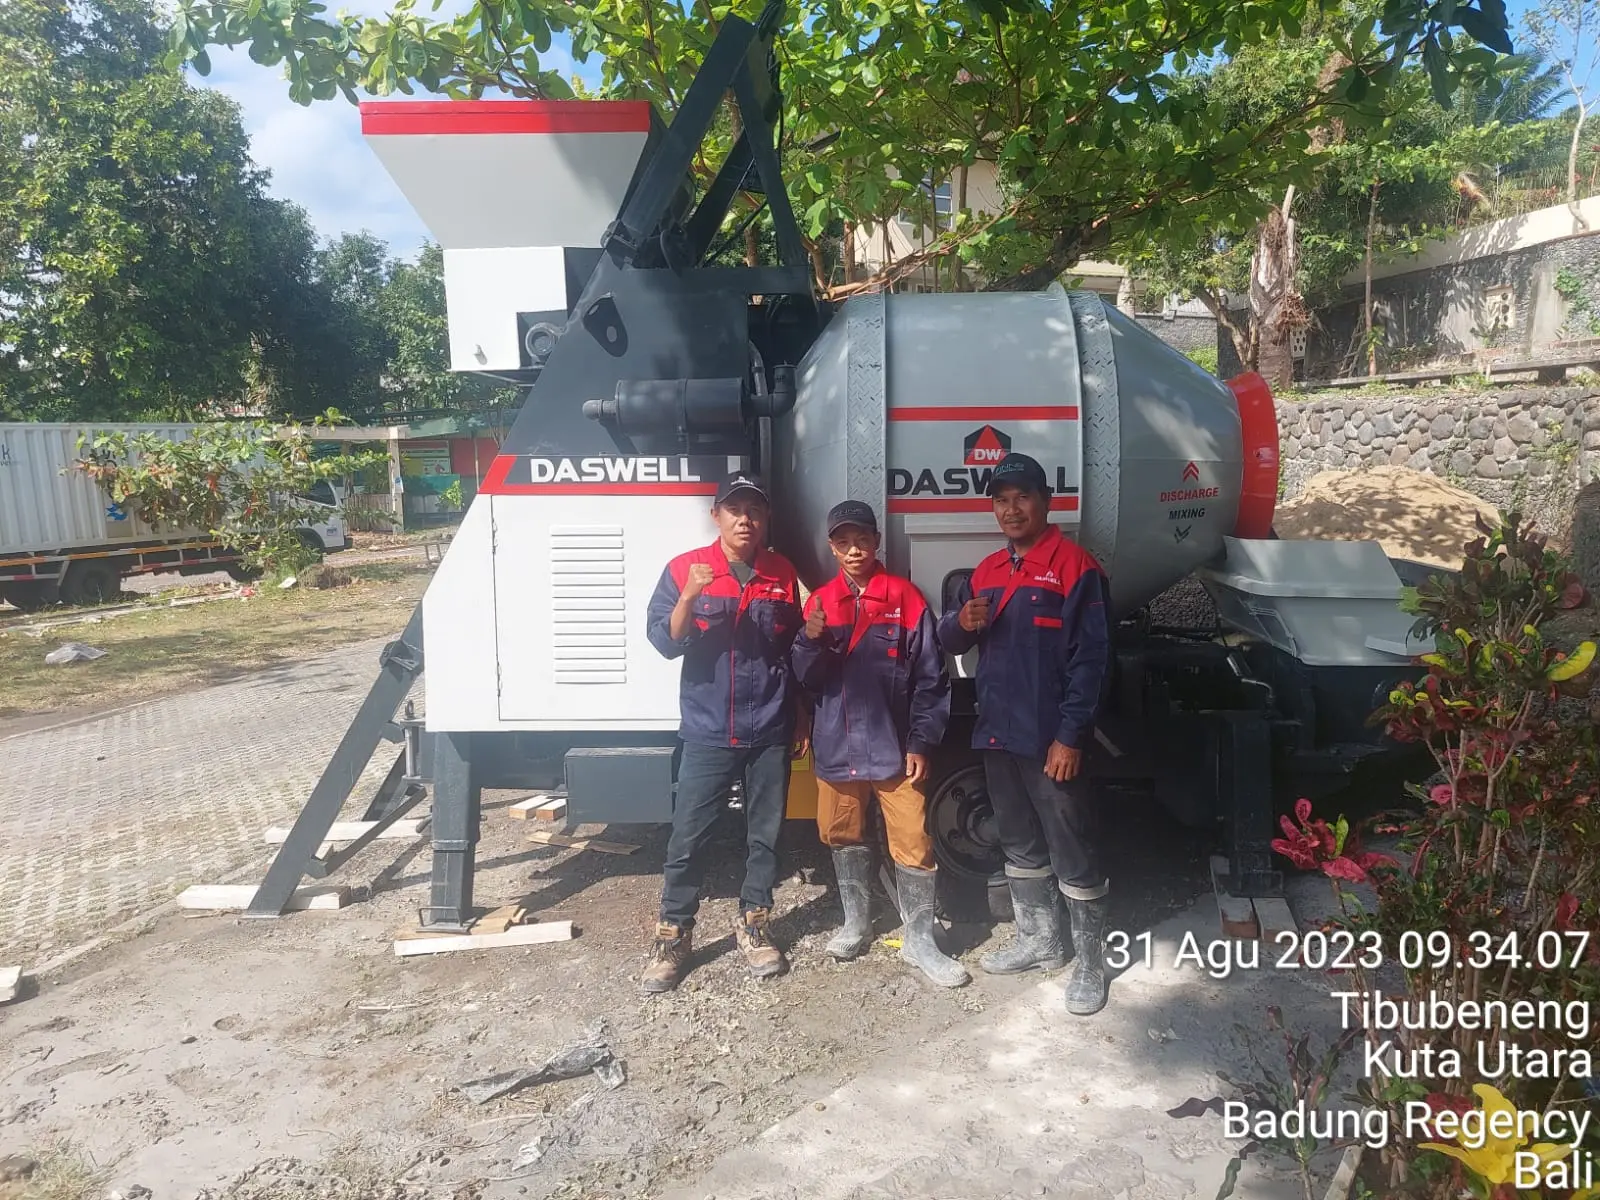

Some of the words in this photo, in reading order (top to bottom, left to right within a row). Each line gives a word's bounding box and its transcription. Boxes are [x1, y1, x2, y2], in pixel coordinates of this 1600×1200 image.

[974, 449, 1002, 461] DW
[530, 457, 701, 483] DASWELL
[887, 467, 1079, 497] DASWL
[1169, 507, 1206, 520] MIXING
